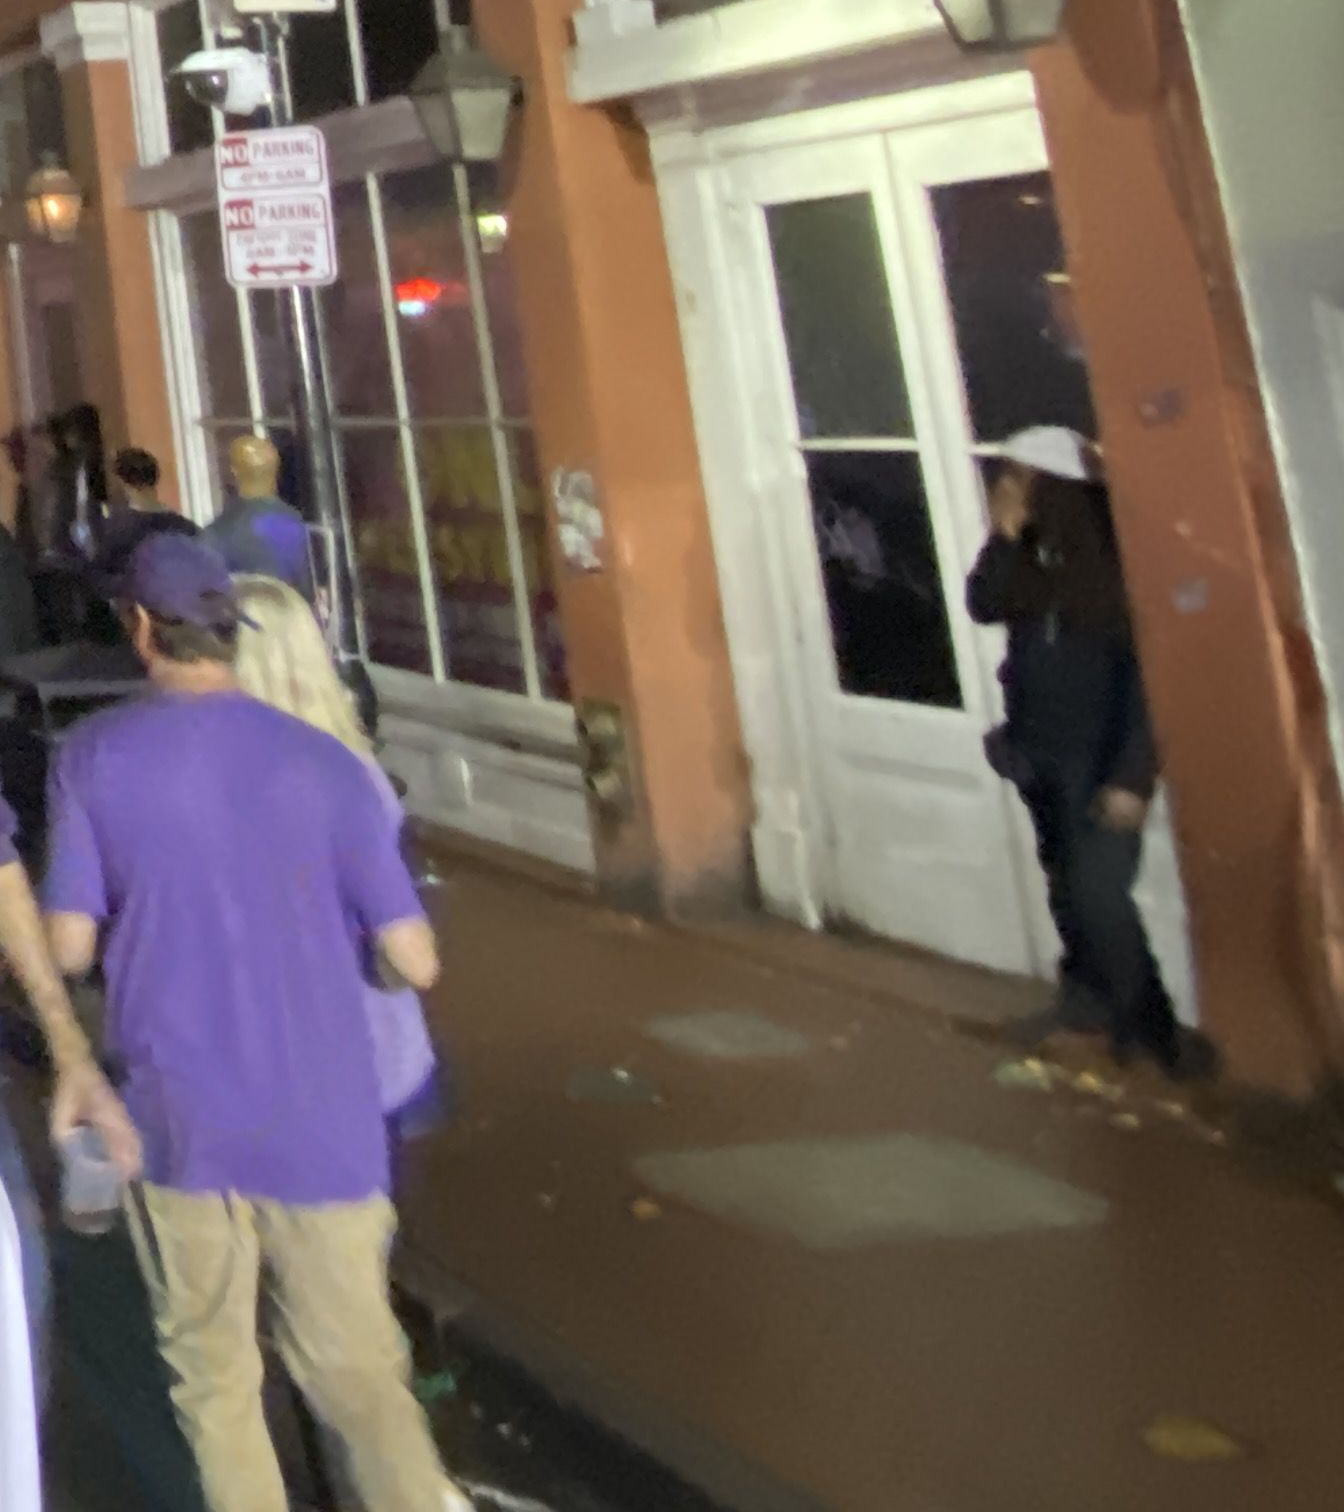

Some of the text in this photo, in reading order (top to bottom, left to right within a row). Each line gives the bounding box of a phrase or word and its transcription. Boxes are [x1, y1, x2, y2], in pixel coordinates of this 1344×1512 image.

[220, 139, 314, 166] NO PARKING
[225, 202, 321, 228] NO PARKING
